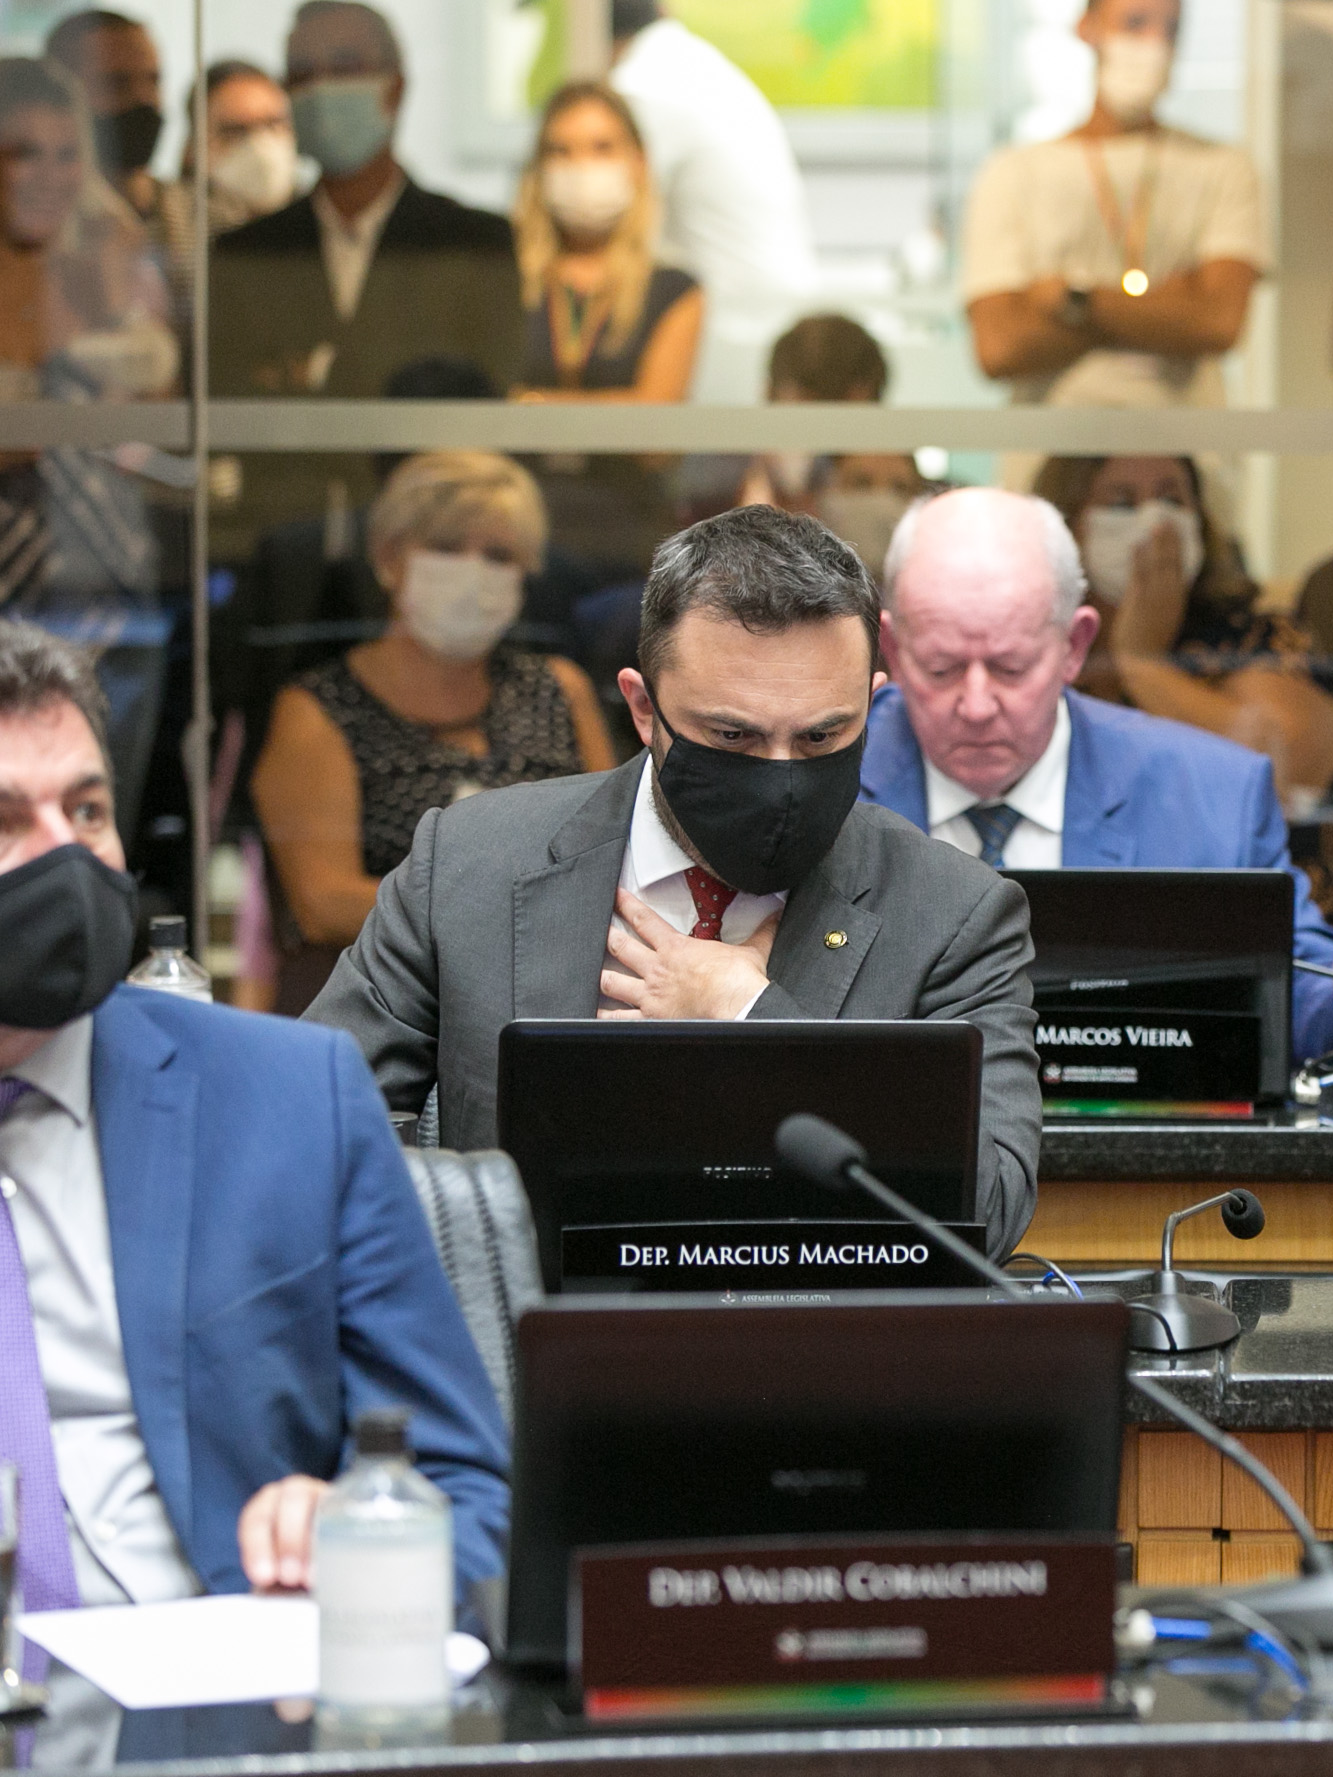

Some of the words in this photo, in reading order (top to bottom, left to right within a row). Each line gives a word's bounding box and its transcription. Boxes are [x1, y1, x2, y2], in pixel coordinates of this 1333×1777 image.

[1036, 1025, 1122, 1046] MARCOS
[1124, 1026, 1194, 1047] VIEIRA
[678, 1244, 790, 1265] MARCIUS
[798, 1243, 928, 1265] MACHADO
[742, 1295, 784, 1303] ASSEMBLEIA
[786, 1294, 832, 1303] LEGISLATIVA
